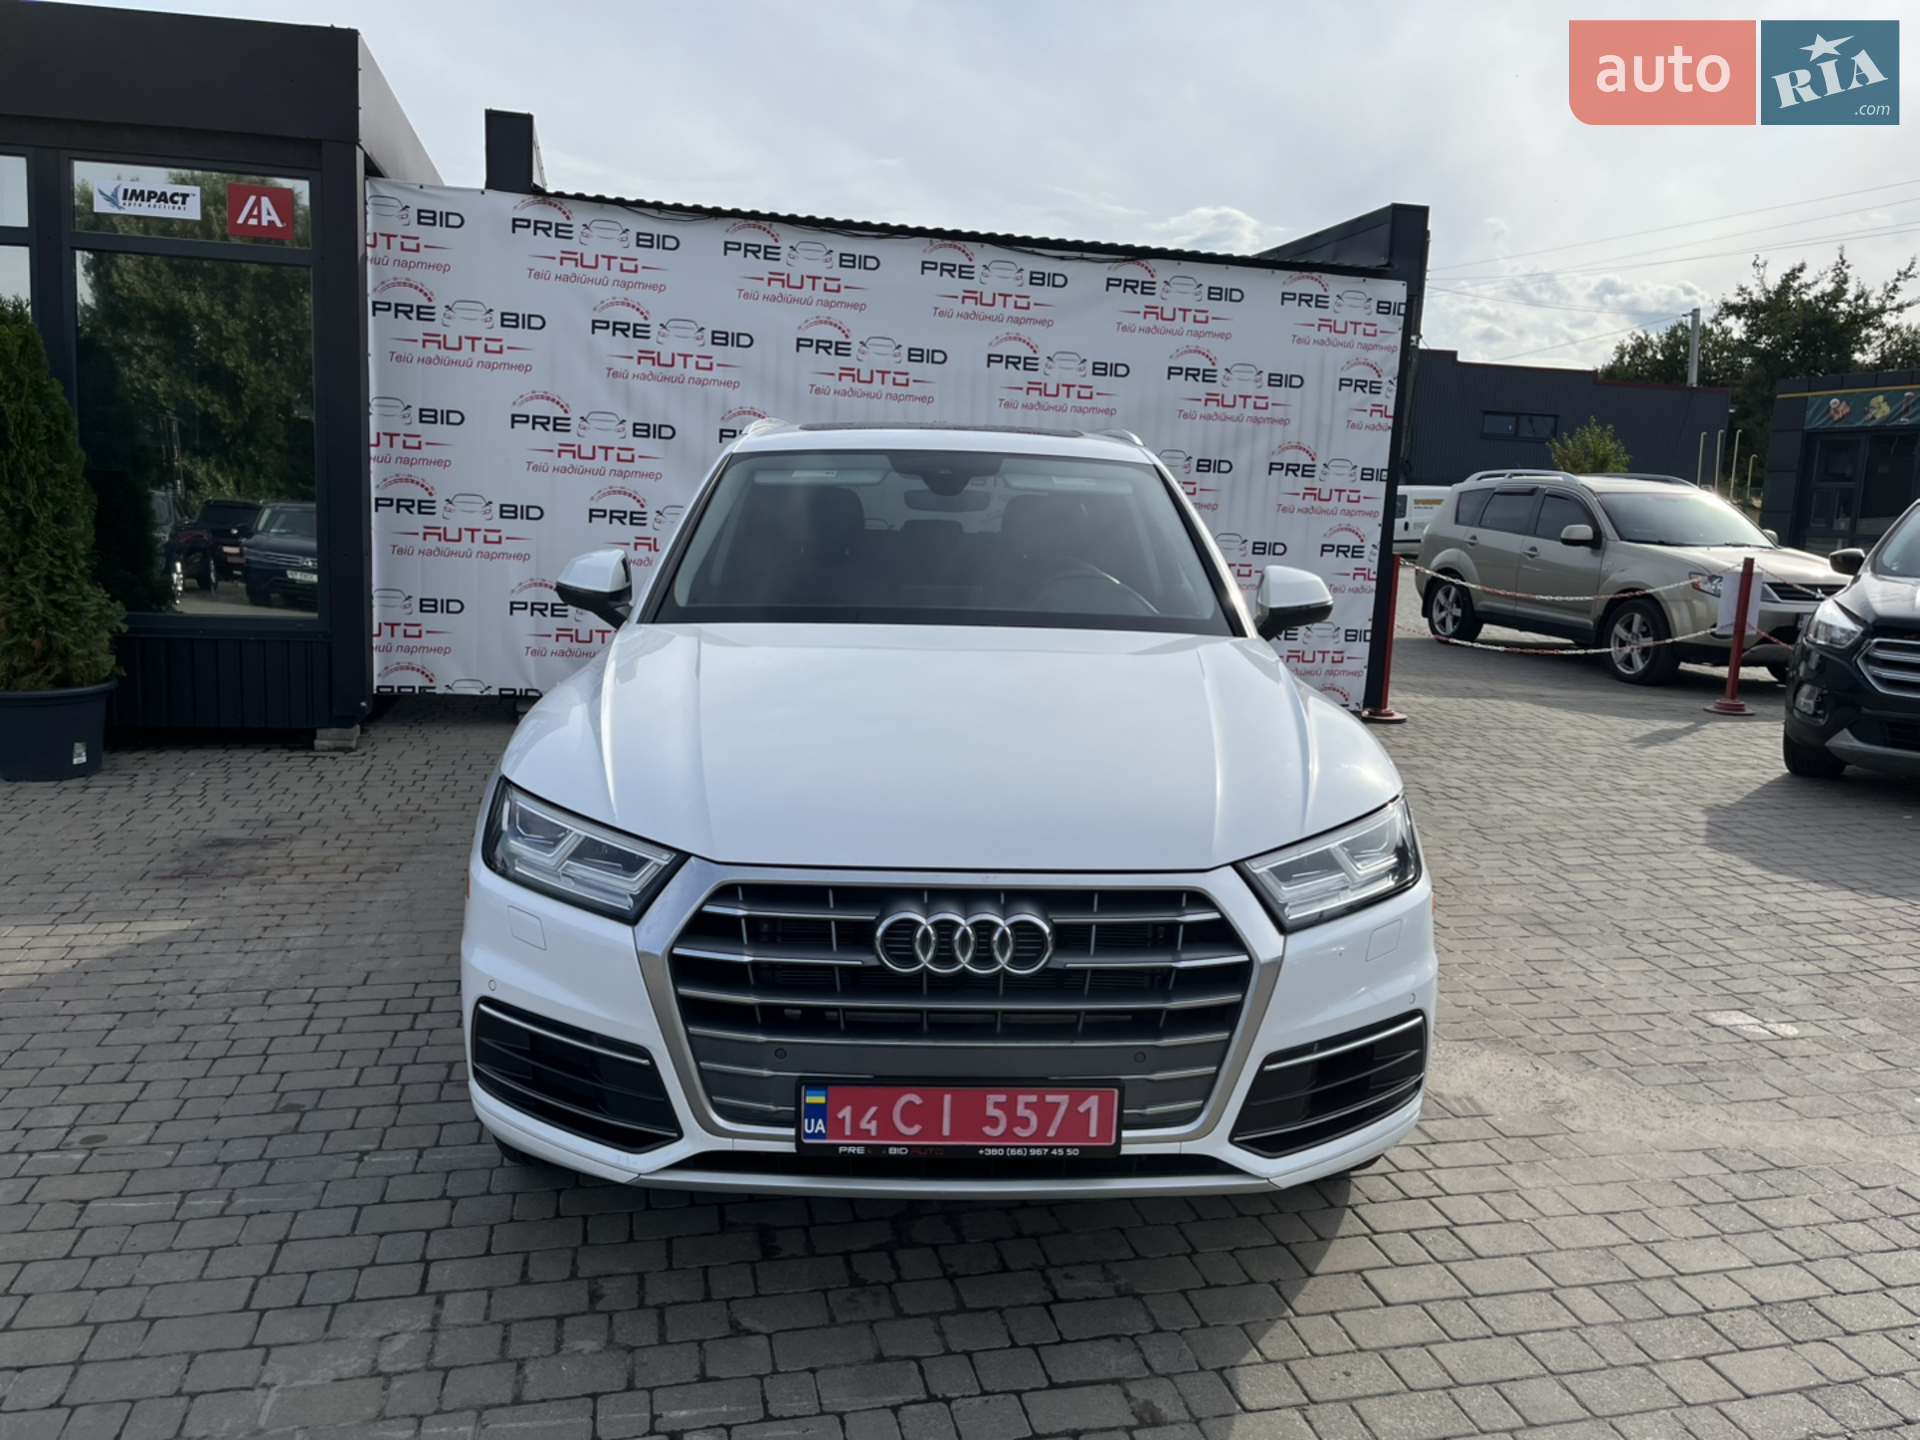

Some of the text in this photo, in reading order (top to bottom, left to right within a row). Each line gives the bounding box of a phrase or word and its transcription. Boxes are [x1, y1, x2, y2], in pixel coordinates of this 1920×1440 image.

[417, 209, 465, 229] BID
[512, 217, 680, 251] PRE BID
[560, 250, 638, 274] AUTO
[724, 240, 880, 271] PRE BID
[393, 259, 451, 274] партнер
[921, 259, 1068, 288] PRE BID
[527, 268, 667, 294] Твій надійний партнер
[767, 271, 841, 293] AUTO
[1106, 276, 1244, 303] PRE BID
[737, 288, 867, 313] Твій надійний партнер
[961, 290, 1030, 310] AUTO
[1281, 290, 1330, 309] PRE
[371, 300, 546, 330] PRE BID
[933, 306, 1054, 329] Твій надійний партнер
[1143, 305, 1209, 324] AUTO
[591, 318, 754, 348] PRE BID
[1116, 322, 1232, 341] Твій надійний партнер
[1317, 318, 1377, 337] AUTO
[422, 333, 504, 354] AUTO
[796, 336, 948, 365] PRE BID
[389, 351, 533, 374] Твій надійний партнер
[637, 349, 713, 371] AUTO
[987, 353, 1130, 378] PRE BID
[606, 367, 741, 390] Твій надійний партнер
[838, 367, 909, 387] AUTO
[1167, 366, 1304, 389] PRE BID
[1338, 376, 1383, 395] PRE
[809, 384, 934, 405] Твій надійний партнер
[1026, 381, 1093, 400] AUTO
[998, 398, 1117, 417] Твій надійний партнер
[1204, 392, 1269, 410] AUTO
[419, 408, 465, 426] BID
[511, 413, 676, 440] PRE BID
[395, 456, 452, 469] партнер
[557, 443, 635, 463] AUTO
[526, 461, 663, 482] Твій надійний партнер
[1196, 458, 1233, 474] BID
[1268, 462, 1316, 478] PRE
[1302, 487, 1361, 503] AUTO
[374, 497, 544, 521] PRE BID
[589, 508, 647, 526] PRE
[423, 526, 502, 545] AUTO
[391, 544, 531, 563] Твій надійний партнер
[1252, 541, 1287, 556] BID
[1320, 544, 1365, 559] PRE
[419, 598, 465, 614] BID
[509, 600, 569, 618] PRE
[555, 627, 617, 645] AUT
[396, 645, 452, 656] партнер
[524, 646, 548, 657] Твій
[1286, 649, 1346, 664] AUTO
[836, 1105, 879, 1137] 14
[981, 1094, 1100, 1138] 5571
[804, 1118, 826, 1134] UA
[838, 1146, 865, 1154] PRE
[888, 1147, 909, 1155] BID
[978, 1148, 1004, 1156] +380
[1050, 1148, 1064, 1156] 45
[1066, 1148, 1080, 1156] 50
